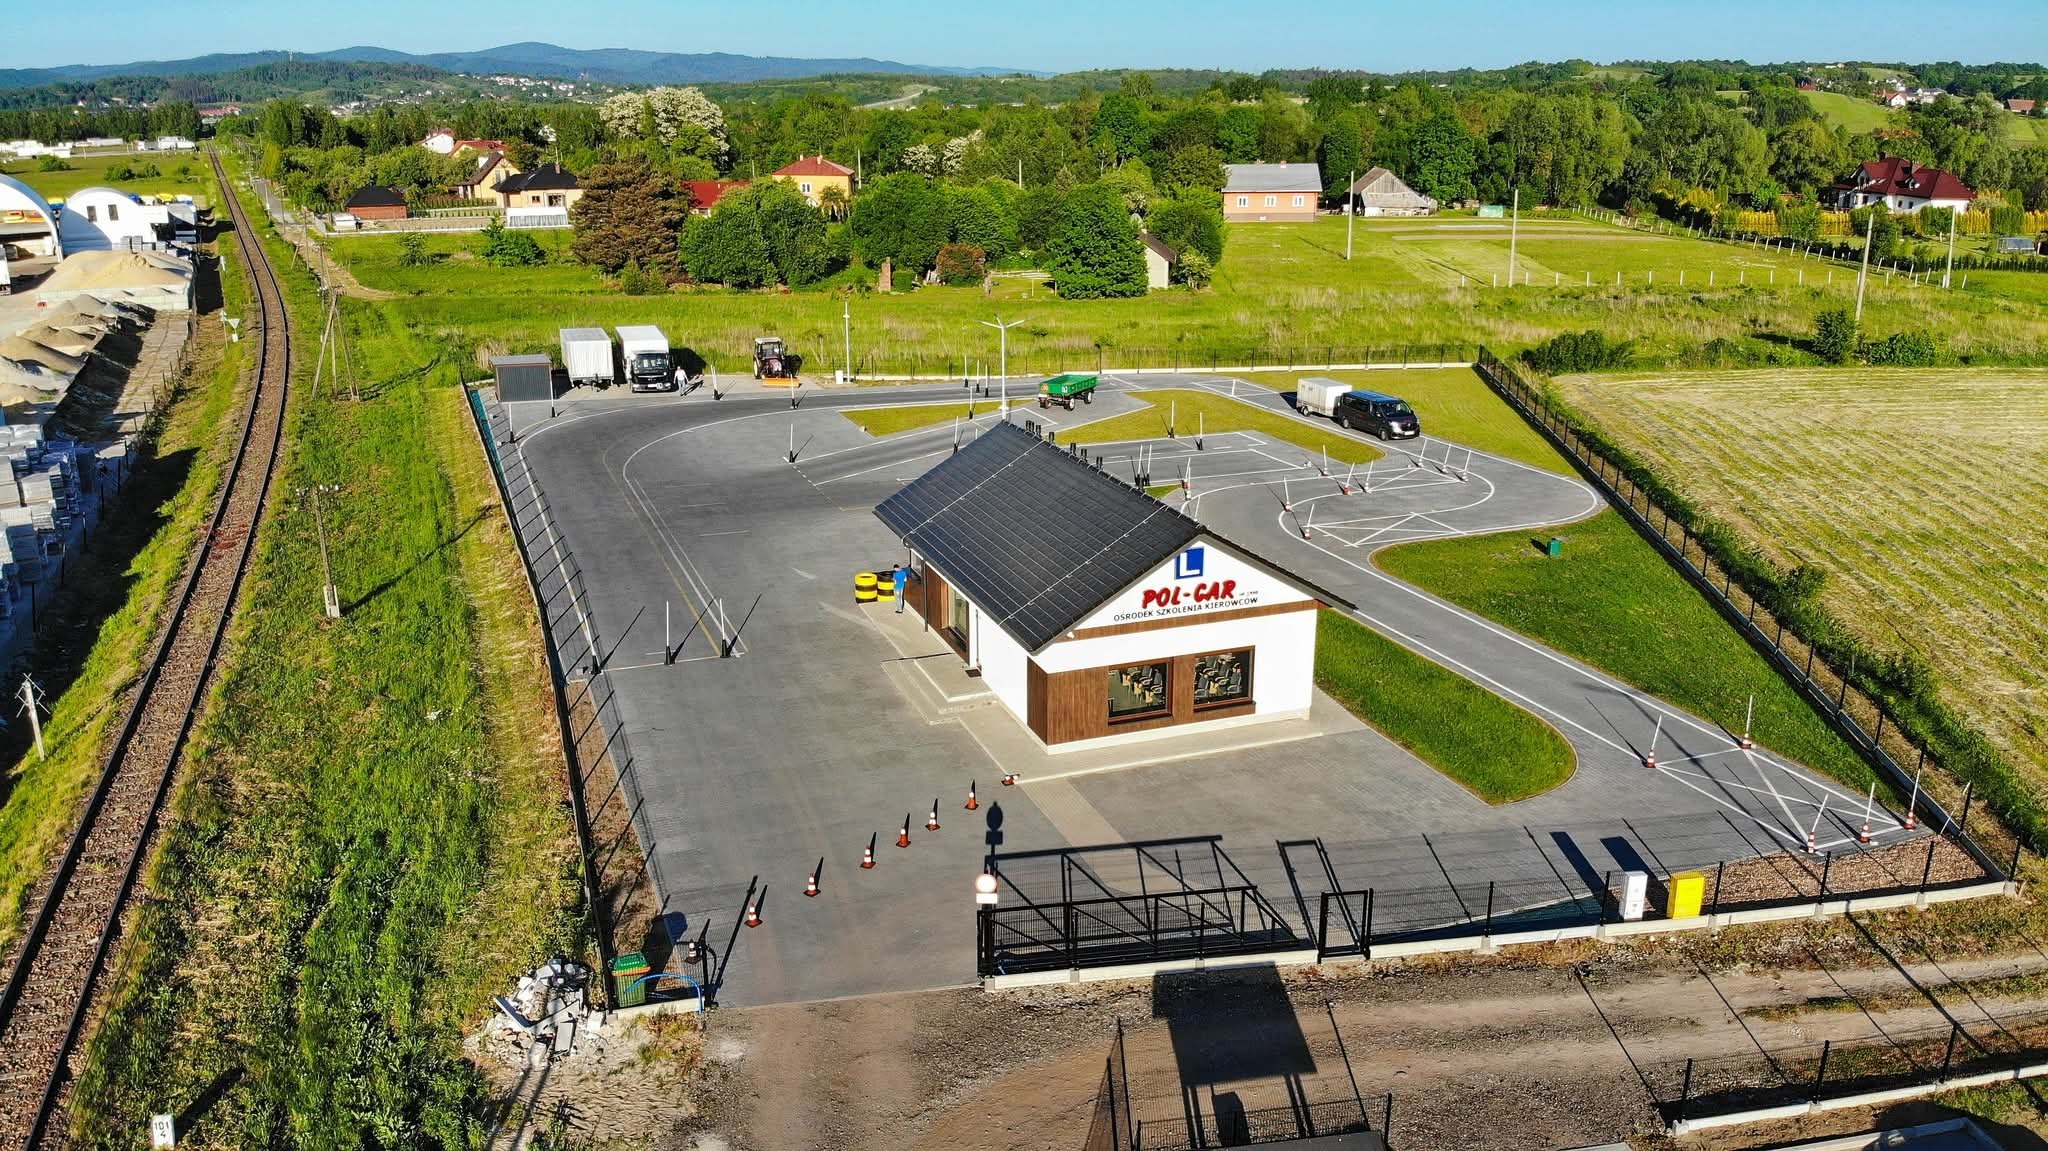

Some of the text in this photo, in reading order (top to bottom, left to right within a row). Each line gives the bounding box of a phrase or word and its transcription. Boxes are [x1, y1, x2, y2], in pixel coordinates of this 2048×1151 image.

[1179, 552, 1201, 577] L
[1156, 604, 1202, 616] SZKOLENIA
[154, 1121, 169, 1130] 101
[160, 1130, 166, 1138] 4
